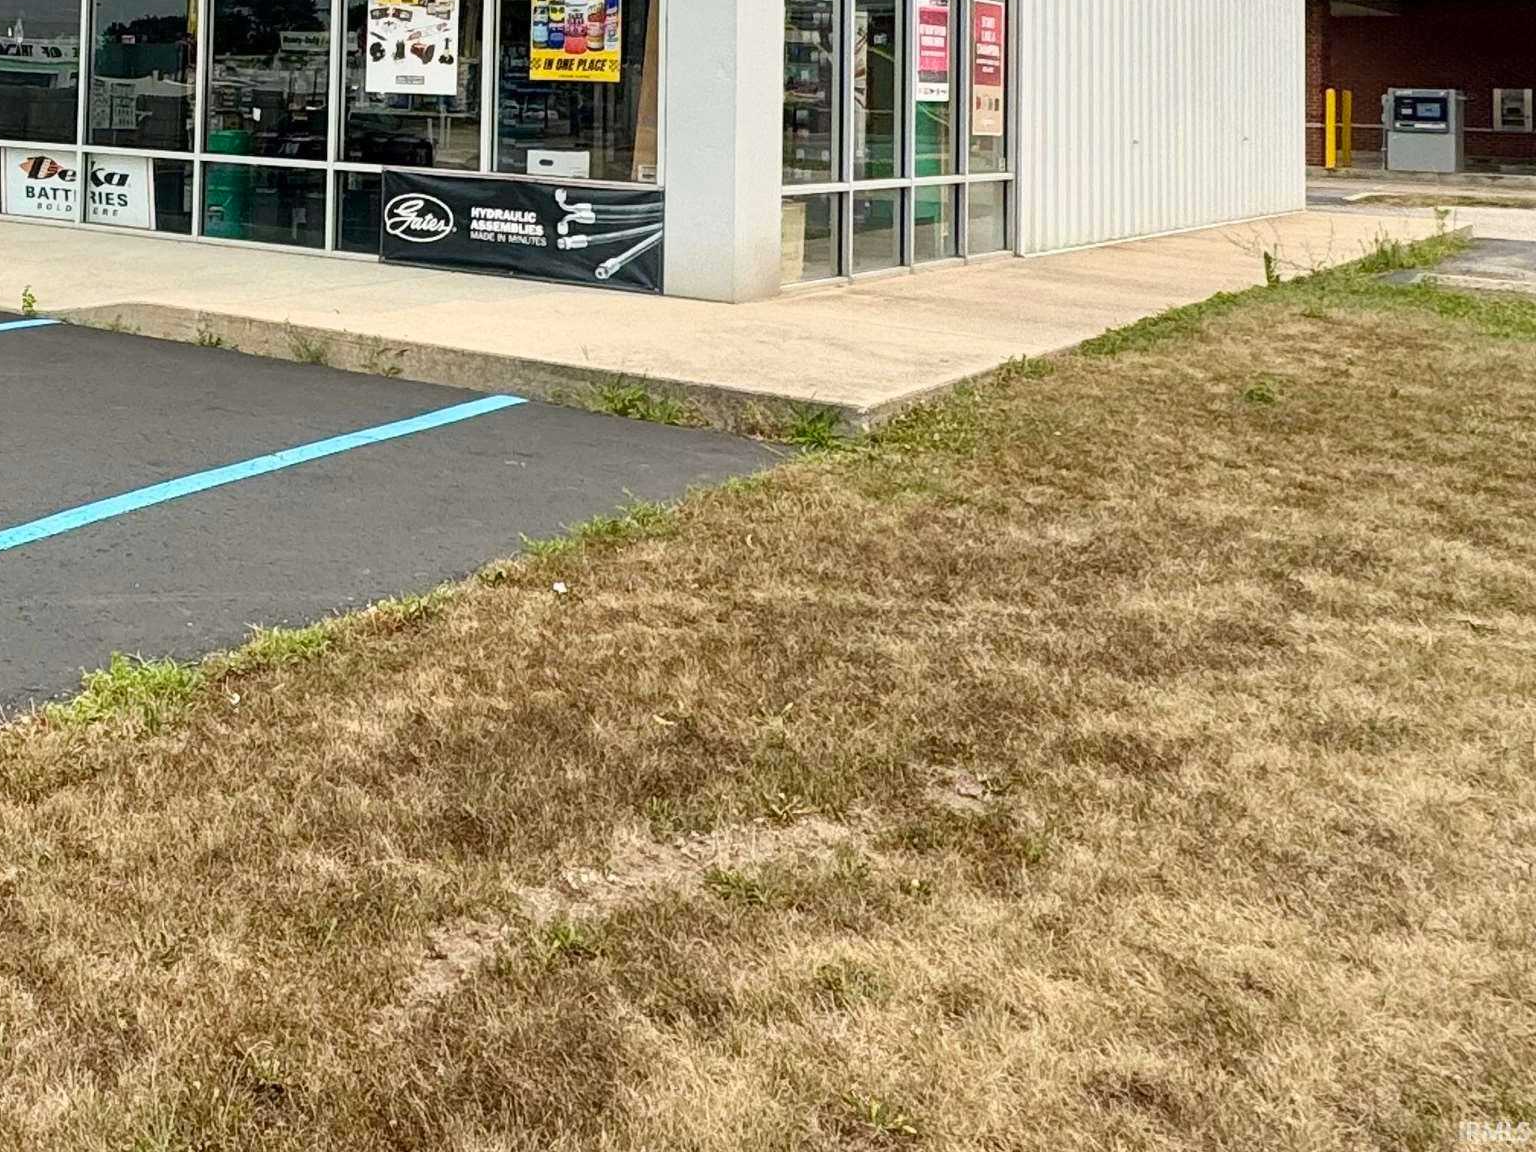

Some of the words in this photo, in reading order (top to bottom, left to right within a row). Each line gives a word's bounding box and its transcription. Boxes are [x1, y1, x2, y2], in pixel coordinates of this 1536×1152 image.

[543, 58, 554, 70] IN
[556, 58, 576, 71] ONE
[576, 58, 607, 72] PLACE
[25, 185, 128, 207] BATTRIES
[388, 199, 450, 234] Gates
[471, 207, 536, 223] HYDRAULIC
[470, 219, 544, 236] ASSEMBLIES
[470, 231, 495, 242] MADE
[497, 234, 506, 243] IN
[508, 235, 547, 247] MINUTES
